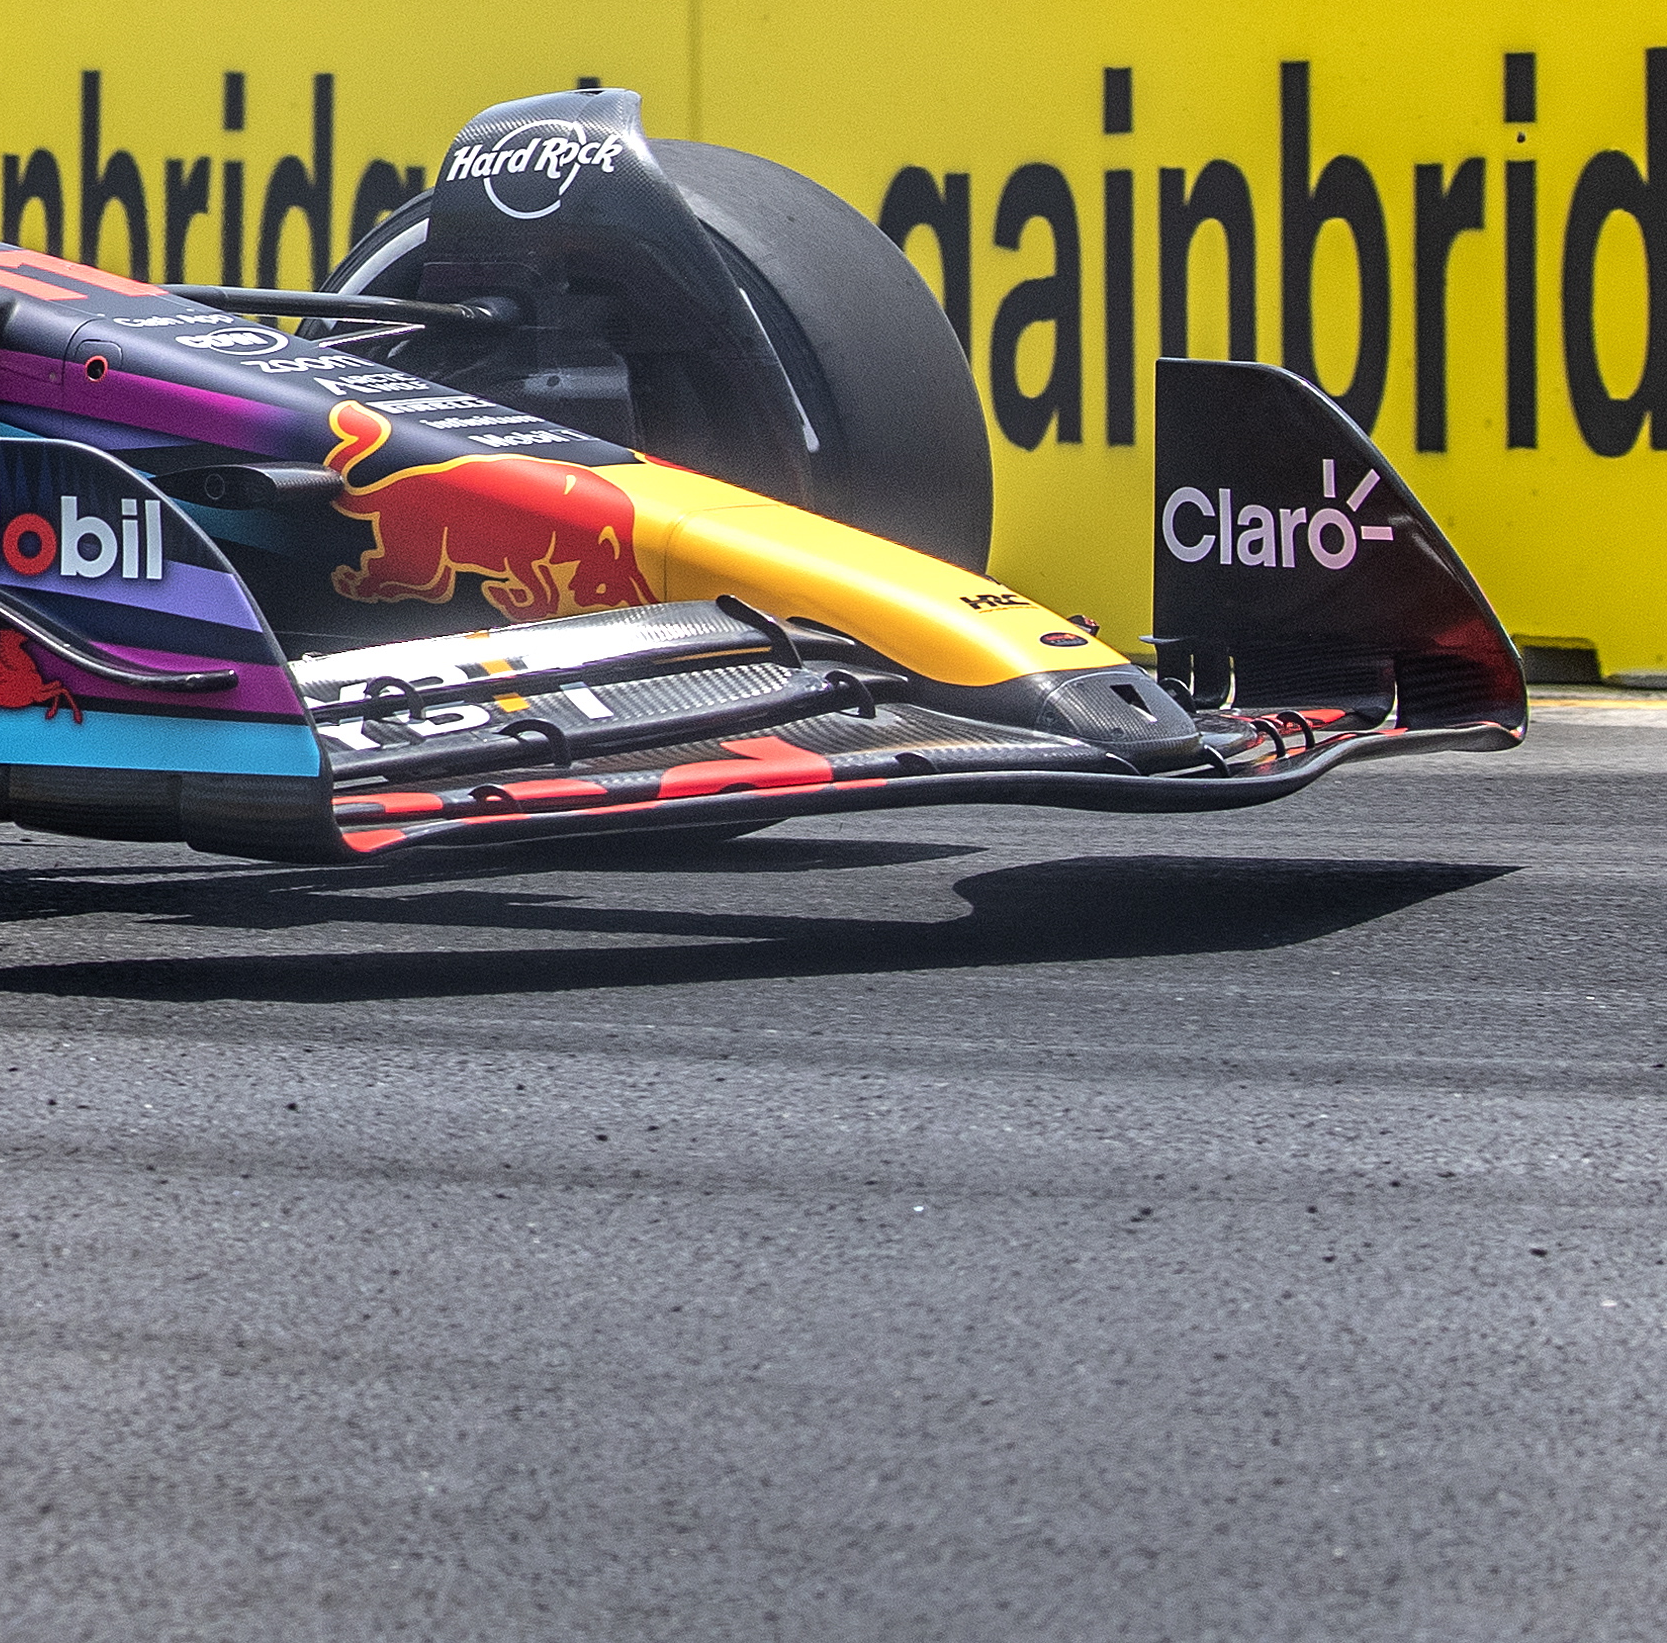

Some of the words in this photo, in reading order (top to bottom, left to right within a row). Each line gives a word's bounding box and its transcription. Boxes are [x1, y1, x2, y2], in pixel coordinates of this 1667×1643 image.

[445, 139, 537, 182] Hard
[533, 136, 623, 178] Rock
[1161, 485, 1359, 571] Claro
